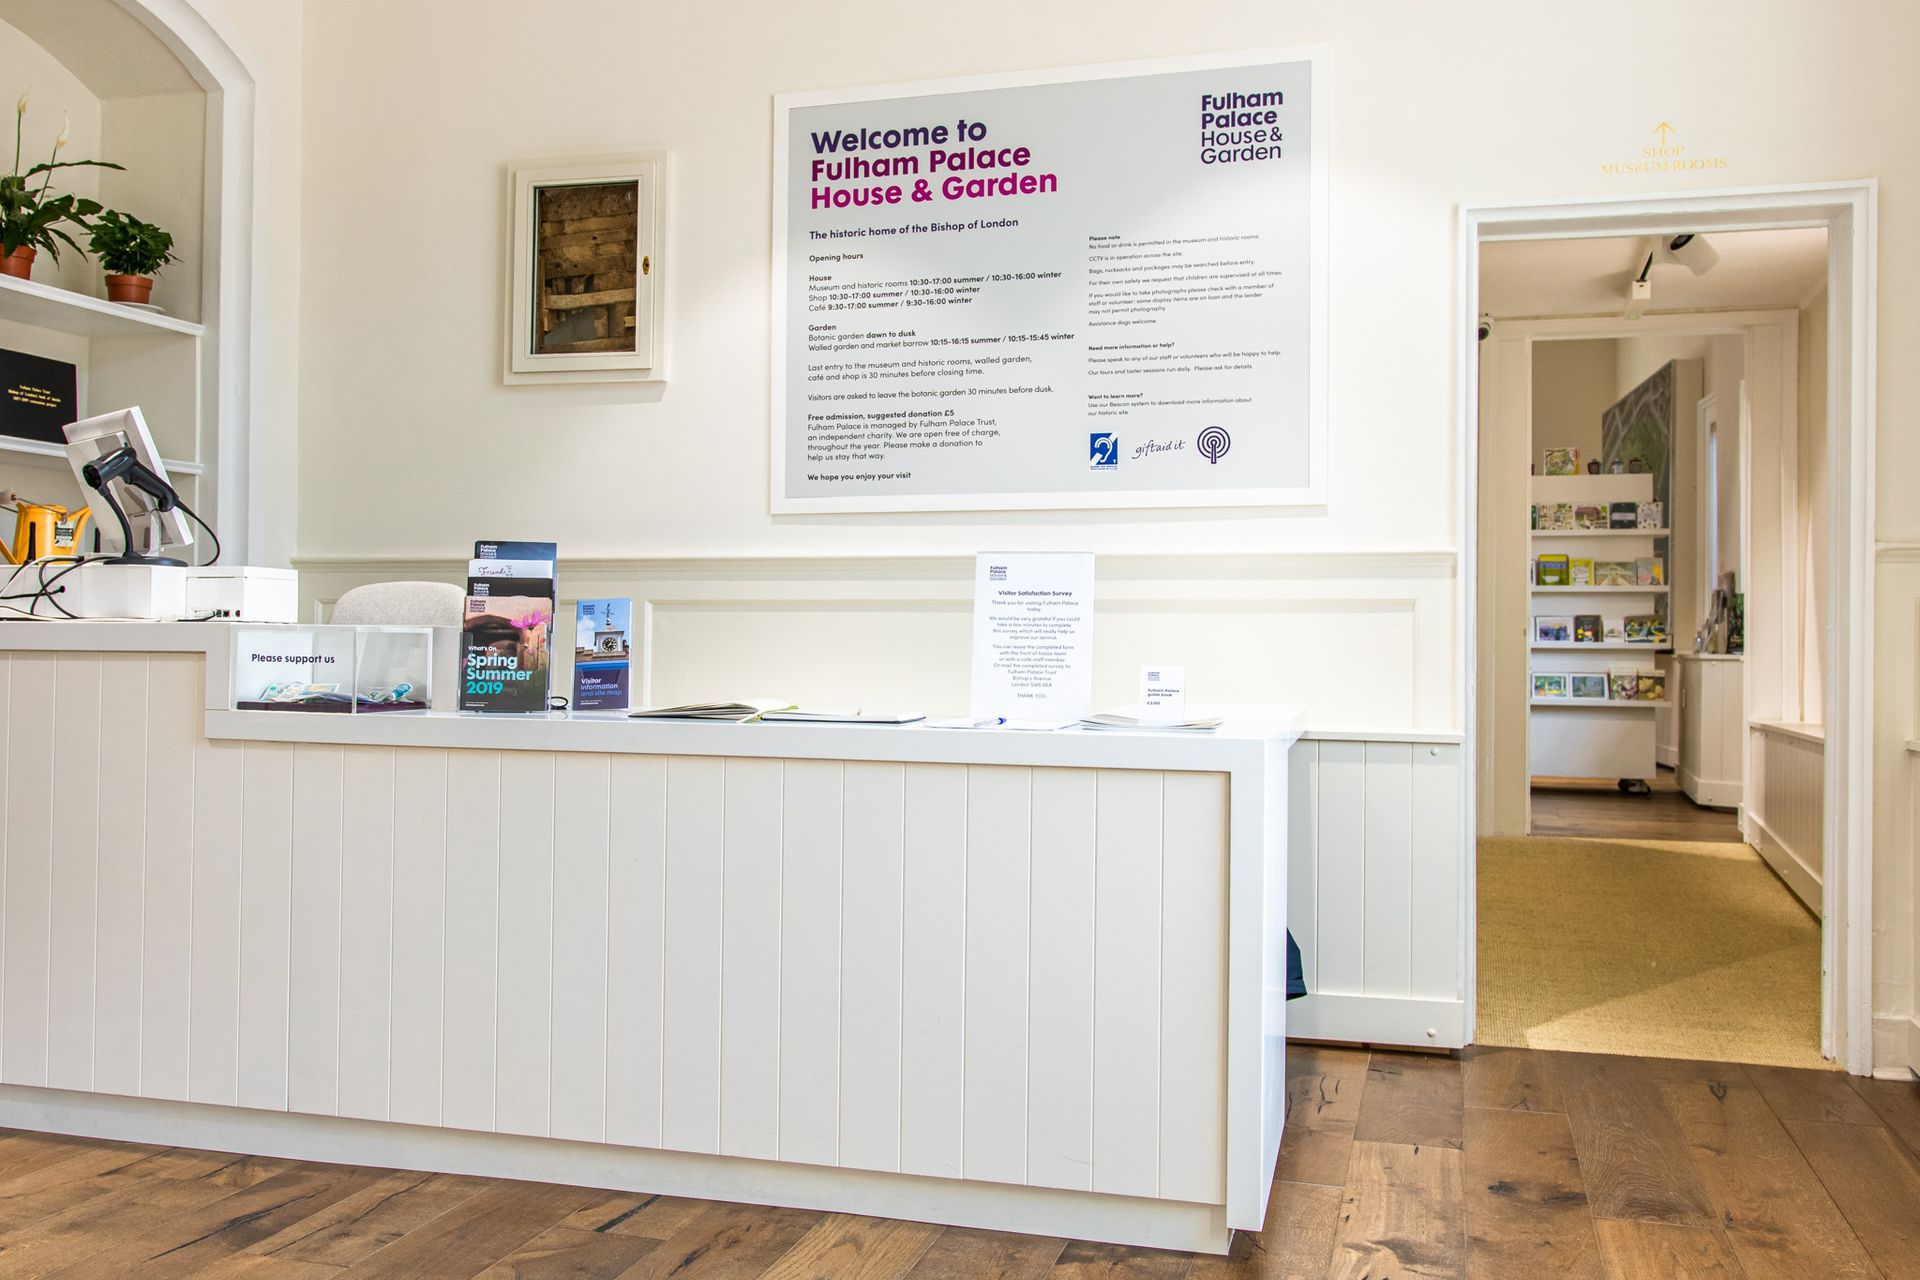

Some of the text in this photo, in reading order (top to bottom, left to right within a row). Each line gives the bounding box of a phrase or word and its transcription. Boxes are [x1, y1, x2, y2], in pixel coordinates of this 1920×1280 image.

[1202, 91, 1283, 111] Fulham
[1202, 110, 1277, 129] Palace
[811, 120, 986, 154] Welcome to
[1201, 145, 1281, 164] Garden
[1643, 145, 1684, 158] SHOP
[812, 147, 1031, 181] Fulham Palace
[1601, 157, 1728, 174] MUSEUM ROOMS
[812, 173, 1057, 209] House & Garden
[809, 218, 1019, 240] The historic home of the Bishop of London
[809, 254, 841, 263] Opening
[909, 277, 952, 286] 10:30-17:00
[991, 272, 1036, 281] 10:30-16:00
[829, 292, 871, 300] 10:30-17:00
[910, 288, 954, 296] 10:30-16:00
[809, 303, 826, 312] Café
[827, 302, 867, 310] 9:30-17:00
[906, 298, 946, 306] 9:30-16:00
[833, 343, 859, 352] garden
[930, 338, 969, 346] 10:15-16:15
[1008, 334, 1049, 342] 10:15-15:45
[837, 333, 865, 342] garden
[1002, 356, 1032, 365] garden,
[937, 369, 964, 377] closing
[939, 389, 966, 398] garden
[867, 411, 907, 420] suggested
[870, 421, 907, 430] managed
[908, 421, 918, 429] by
[820, 474, 839, 482] hope
[855, 473, 876, 481] enjoy
[251, 654, 283, 662] Please
[284, 655, 322, 664] support
[468, 653, 518, 669] Spring
[467, 667, 532, 680] Summer
[466, 681, 504, 694] 2019
